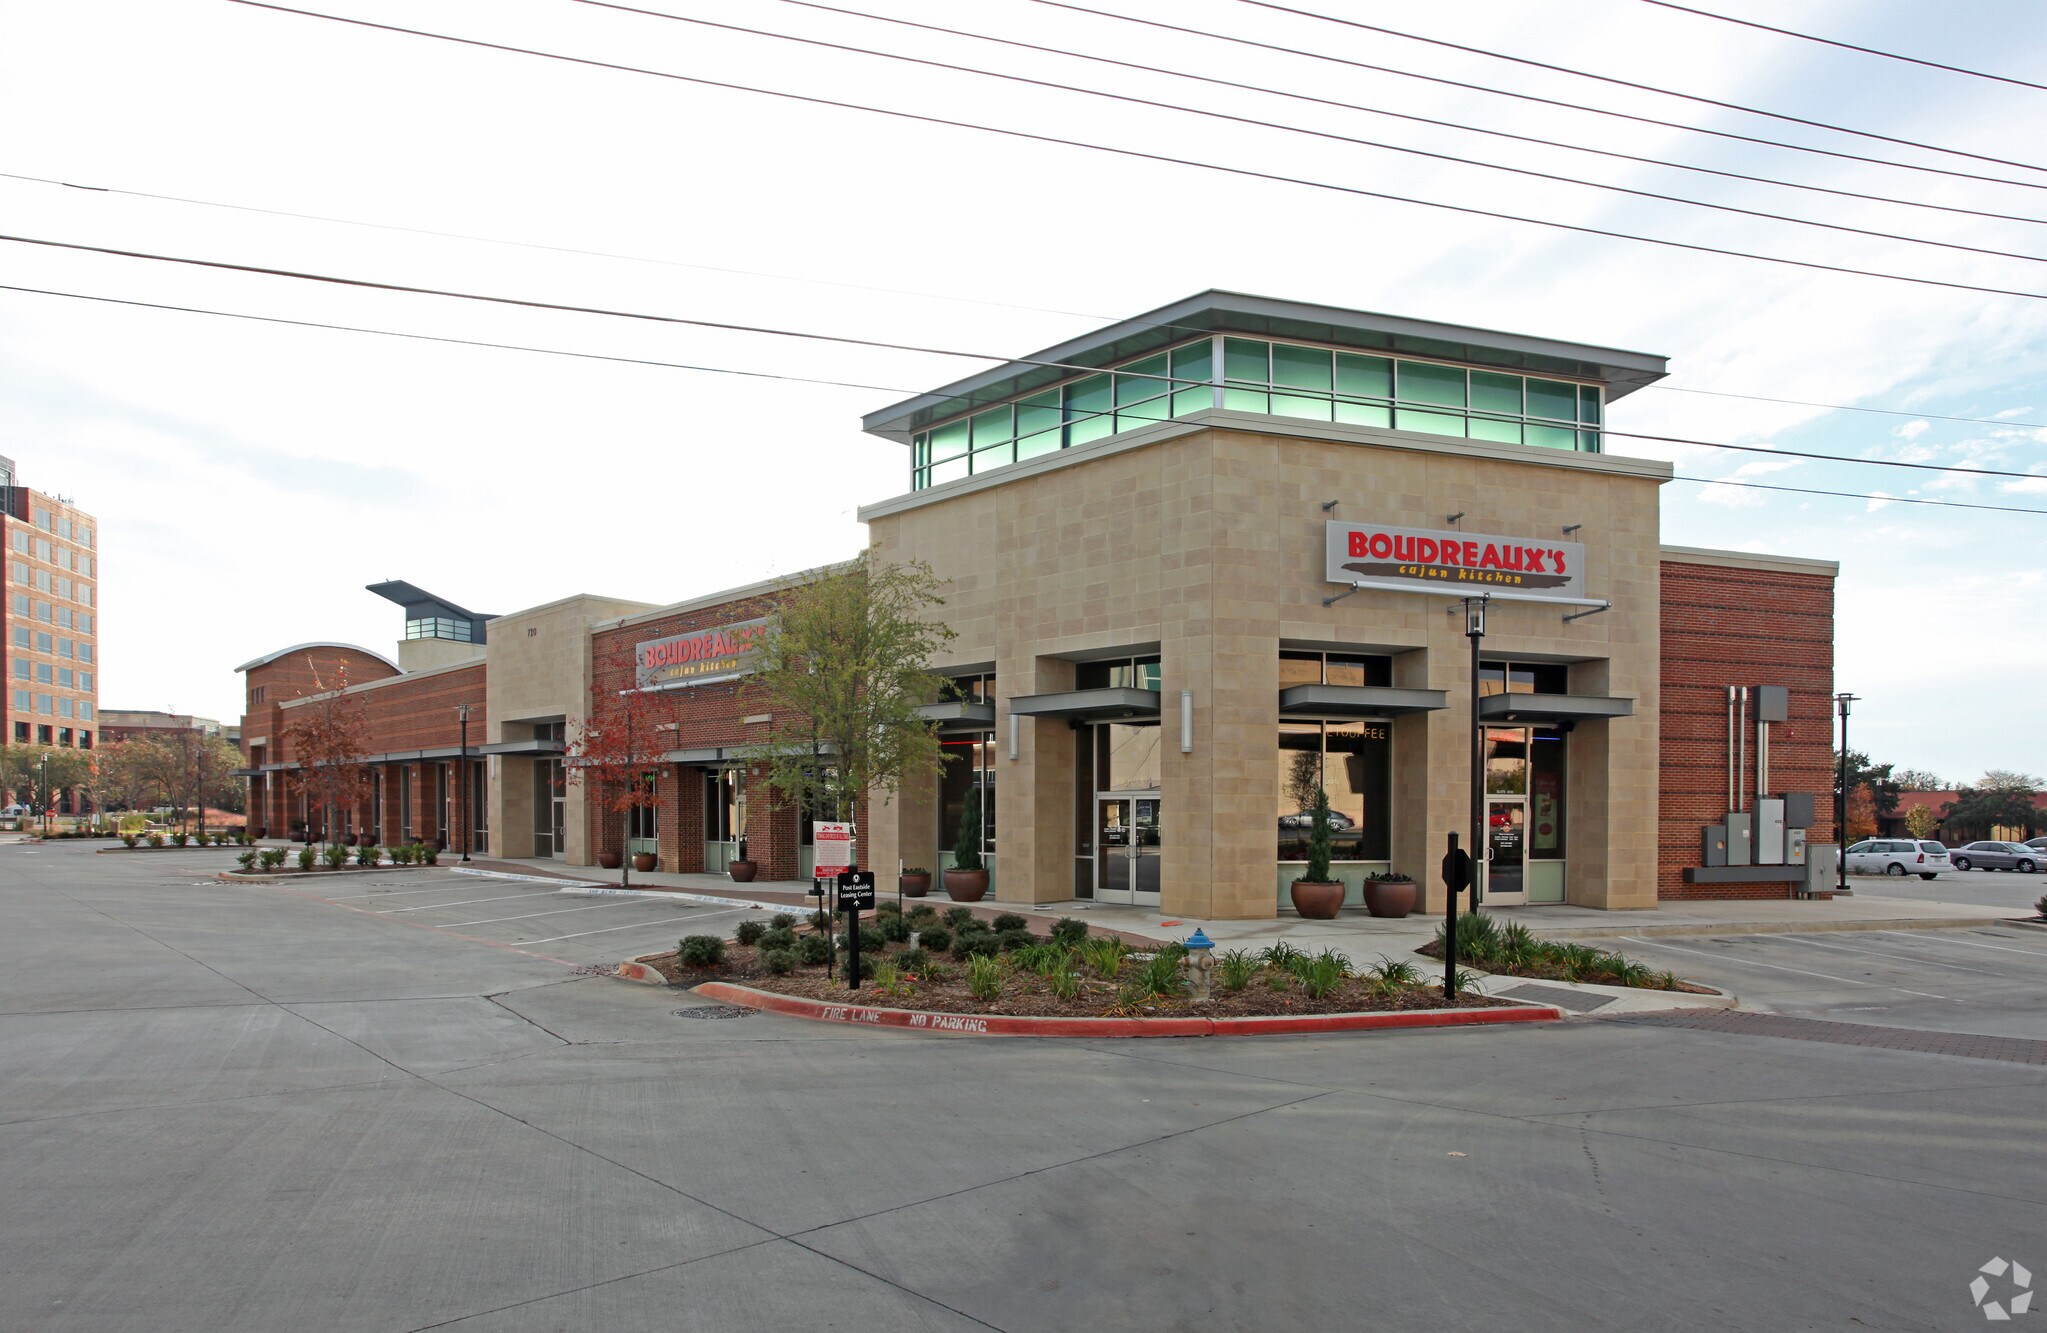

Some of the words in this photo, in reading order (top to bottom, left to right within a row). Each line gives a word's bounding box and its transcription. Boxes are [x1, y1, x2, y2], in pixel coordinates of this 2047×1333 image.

[1348, 531, 1567, 575] BOUDREAUX'S
[1399, 564, 1449, 580] cajun
[1458, 567, 1522, 585] kitchen
[822, 1007, 848, 1020] FIRE
[851, 1009, 882, 1024] LANE
[909, 1014, 927, 1027] NO
[931, 1016, 988, 1033] PARKING
